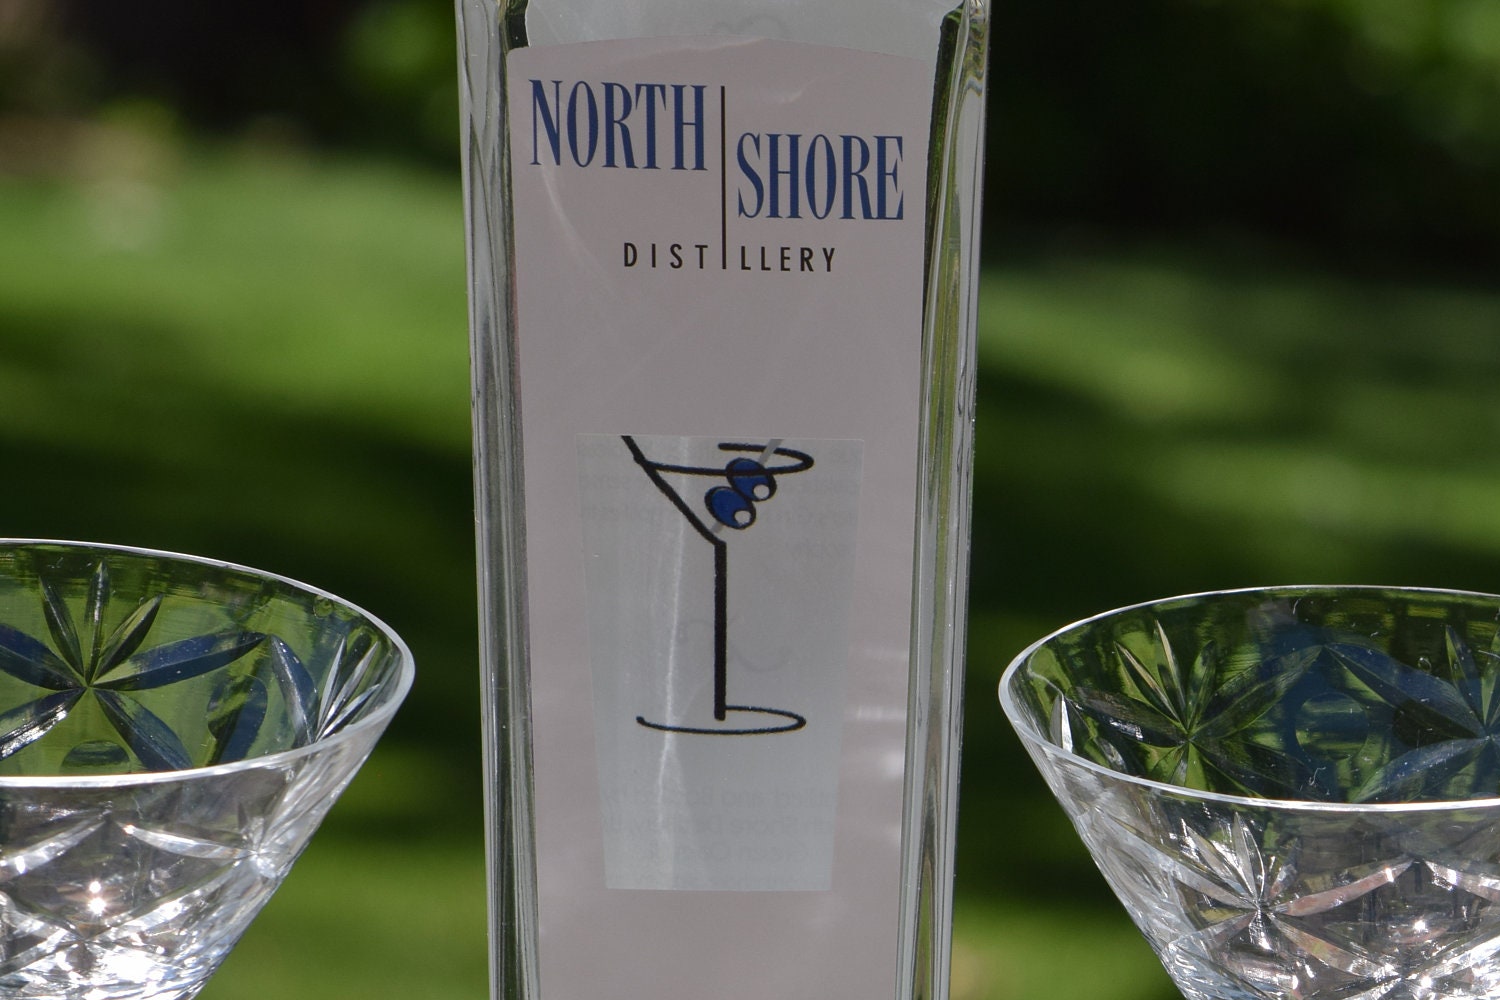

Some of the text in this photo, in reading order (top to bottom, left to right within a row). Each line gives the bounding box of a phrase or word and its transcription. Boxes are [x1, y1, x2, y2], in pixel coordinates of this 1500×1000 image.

[528, 79, 904, 221] NORTH SHORE
[623, 242, 836, 273] DISTILLERY
